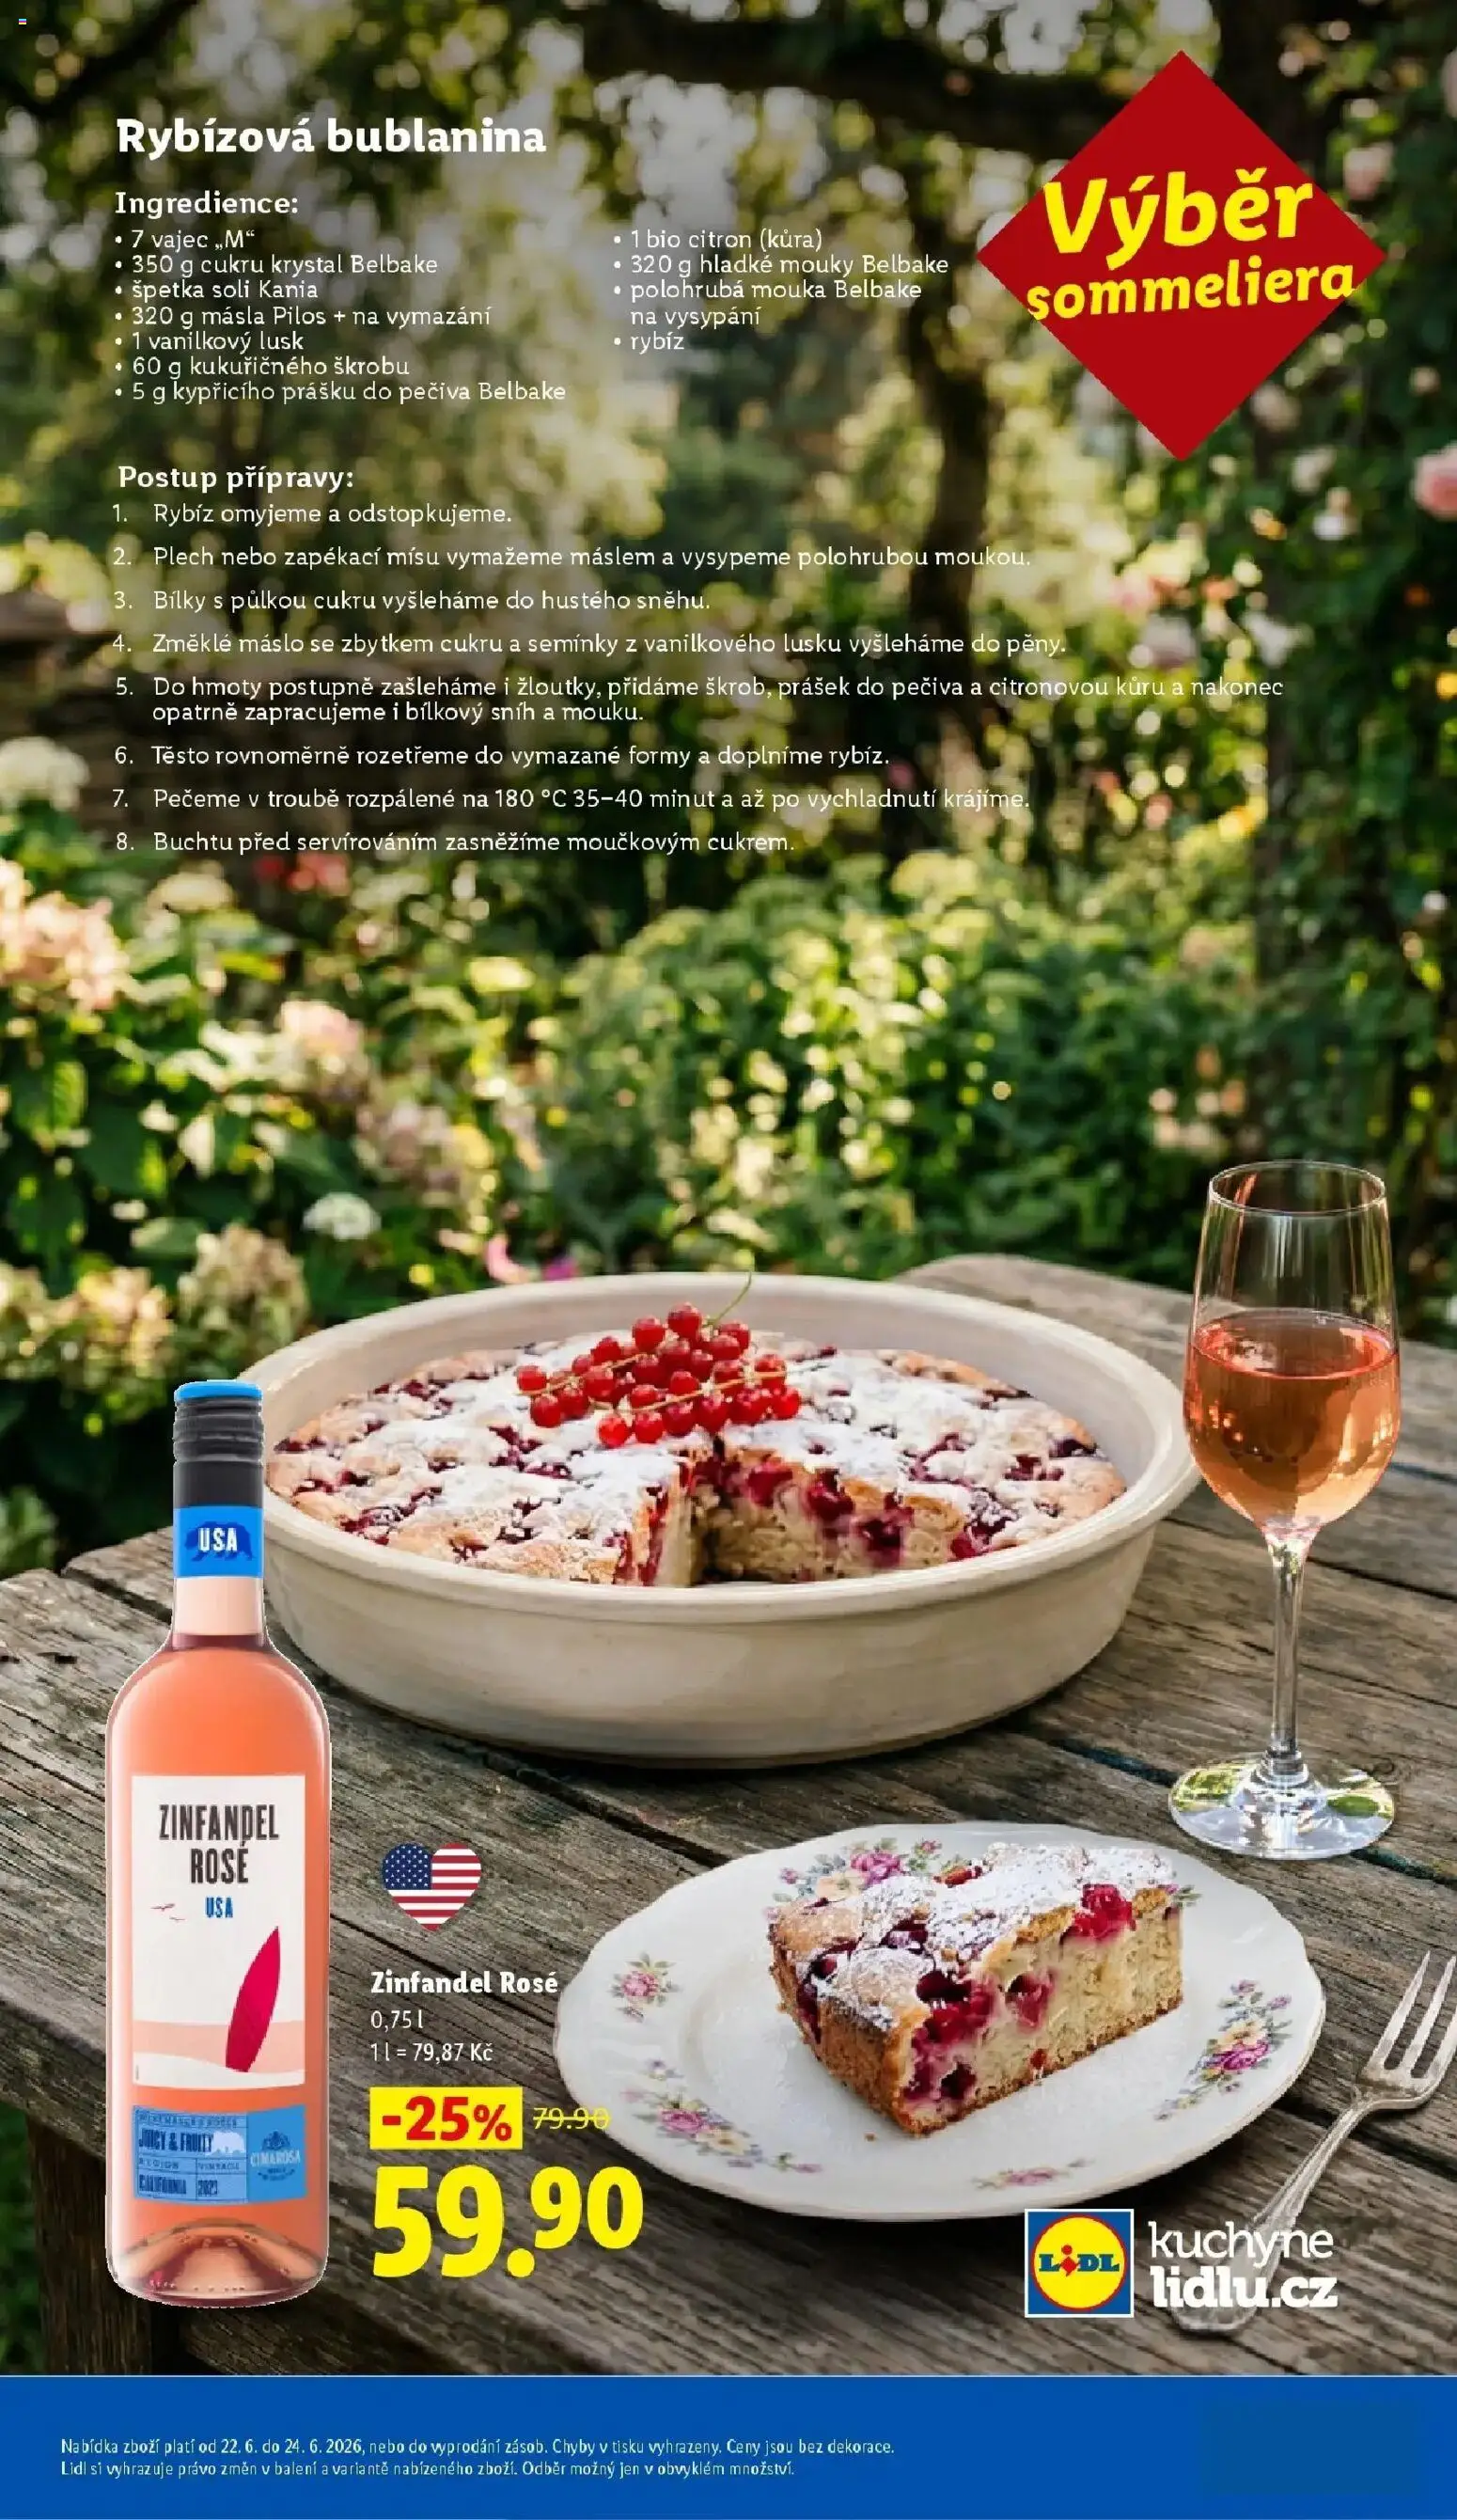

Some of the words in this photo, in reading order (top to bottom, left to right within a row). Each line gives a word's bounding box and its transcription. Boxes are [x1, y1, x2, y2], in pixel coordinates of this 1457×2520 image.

[117, 117, 315, 161] Rybízová
[328, 117, 546, 152] bublanina
[115, 190, 298, 219] Ingredience:
[1044, 167, 1313, 270] Výběr
[132, 229, 144, 247] 7
[151, 229, 208, 252] vajec
[632, 229, 638, 247] 1
[648, 229, 680, 247] bio
[689, 230, 751, 247] citron
[760, 228, 822, 252] (kůra)
[133, 255, 173, 273] 350
[180, 260, 193, 277] g
[201, 254, 264, 273] cukru
[272, 254, 342, 277] krystal
[351, 254, 437, 273] Belbake
[632, 255, 671, 273] 320
[679, 260, 690, 277] g
[701, 254, 773, 273] hladké
[779, 254, 854, 277] mouky
[862, 254, 948, 273] Belbake
[133, 279, 205, 301] špetka
[212, 279, 249, 298] soli
[259, 280, 318, 298] Kania
[631, 278, 744, 303] polohrubá
[751, 279, 826, 298] mouka
[834, 279, 921, 298] Belbake
[1027, 255, 1354, 321] sommeliera
[133, 307, 173, 324] 320
[180, 311, 193, 330] g
[201, 306, 265, 324] másla
[273, 306, 326, 324] Pilos
[334, 311, 346, 322] +
[352, 311, 380, 324] na
[386, 307, 492, 329] vymazání
[631, 312, 657, 324] na
[666, 307, 761, 330] vysypání
[133, 332, 139, 350] 1
[149, 331, 251, 354] vanilkový
[260, 331, 304, 350] lusk
[631, 331, 684, 354] rybíz
[133, 356, 161, 374] 60
[168, 362, 180, 379] g
[191, 355, 327, 375] kukuřičného
[334, 355, 409, 374] škrobu
[133, 383, 144, 400] 5
[153, 386, 164, 404] g
[281, 381, 356, 404] prášku
[363, 381, 391, 400] do
[399, 383, 470, 404] pečiva
[478, 381, 565, 400] Belbake
[118, 466, 217, 494] Postup
[227, 465, 352, 494] přípravy:
[113, 504, 127, 522] 1.
[154, 503, 214, 527] Rybíz
[221, 504, 321, 527] omyjeme
[329, 509, 340, 522] a
[349, 503, 511, 527] odstopkujeme.
[114, 591, 132, 608] 3.
[154, 591, 205, 613] Bílky
[214, 596, 223, 608] s
[231, 590, 306, 613] půlkou
[314, 590, 376, 609] cukru
[383, 590, 498, 613] vyšleháme
[507, 591, 534, 608] do
[542, 591, 630, 608] hustého
[637, 590, 710, 609] sněhu.
[113, 789, 128, 807] 7.
[154, 789, 240, 807] Pečeme
[249, 795, 258, 807] v
[268, 788, 339, 807] troubě
[346, 788, 454, 812] rozpálené
[462, 795, 489, 807] na
[495, 789, 534, 807] 180
[650, 789, 714, 807] minut
[722, 795, 733, 807] a
[742, 789, 764, 807] až
[772, 795, 799, 812] po
[808, 788, 937, 811] vychladnutí
[945, 788, 1028, 811] krájíme.
[197, 1527, 237, 1552] USA
[159, 1804, 279, 1840] ZINFANDEL
[191, 1840, 249, 1884] ROSÉ
[205, 1897, 233, 1918] USA
[370, 1971, 492, 1994] Zinfandel
[500, 1971, 558, 1994] Rosé
[370, 2010, 413, 2032] 0,75
[370, 2043, 378, 2062] 1
[397, 2049, 407, 2057] =
[413, 2043, 463, 2065] 79,87
[471, 2042, 494, 2062] Kč
[382, 2096, 512, 2142] -25%
[532, 2107, 611, 2131] 79.90
[372, 2165, 644, 2278] 59.90
[1148, 2221, 1334, 2269] kuchyne
[1150, 2265, 1339, 2308] lidlu.cz
[61, 2438, 118, 2453] Nabídka
[123, 2439, 160, 2453] zboží
[164, 2439, 196, 2457] platí
[198, 2439, 218, 2453] od
[221, 2438, 241, 2453] 22.
[245, 2439, 258, 2453] 6.
[262, 2439, 279, 2453] do
[285, 2438, 305, 2453] 24.
[310, 2439, 321, 2453] 6.
[326, 2439, 365, 2456] 2026,
[370, 2439, 404, 2453] nebo
[409, 2439, 427, 2453] do
[431, 2438, 500, 2457] vyprodání
[505, 2438, 548, 2453] zásob.
[553, 2439, 595, 2457] Chyby
[600, 2443, 607, 2453] v
[613, 2438, 643, 2453] tisku
[649, 2439, 722, 2457] vyhrazeny.
[727, 2439, 760, 2457] Ceny
[764, 2440, 792, 2456] jsou
[799, 2439, 823, 2453] bez
[827, 2438, 894, 2453] dekorace.
[62, 2461, 86, 2475] Lidl
[91, 2462, 102, 2475] si
[106, 2461, 173, 2479] vyhrazuje
[178, 2461, 216, 2479] právo
[221, 2461, 258, 2475] změn
[261, 2465, 270, 2475] v
[275, 2461, 317, 2475] balení
[321, 2465, 328, 2475] a
[333, 2462, 388, 2475] variantě
[394, 2461, 474, 2475] nabízeného
[478, 2461, 517, 2475] zboží.
[523, 2461, 566, 2475] Odběr
[571, 2461, 615, 2479] možný
[619, 2462, 639, 2479] jen
[644, 2465, 653, 2475] v
[658, 2461, 724, 2479] obvyklém
[730, 2461, 794, 2475] množství.
